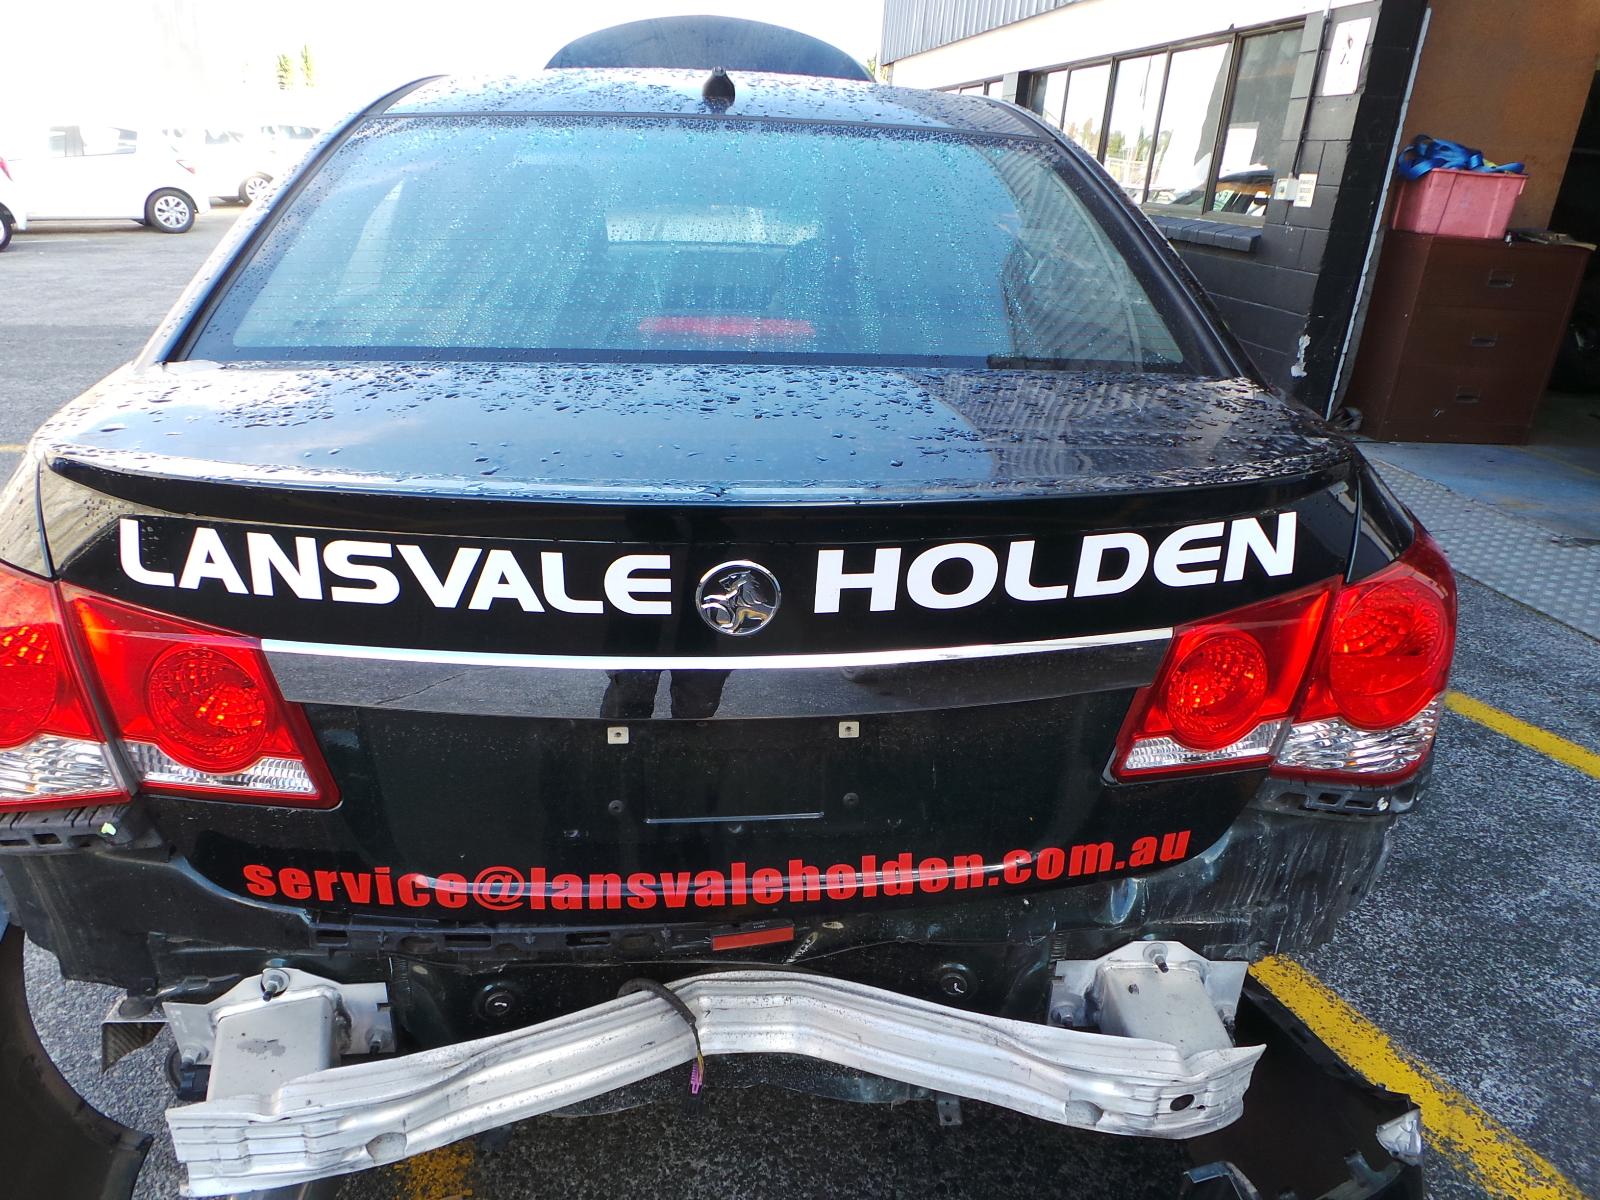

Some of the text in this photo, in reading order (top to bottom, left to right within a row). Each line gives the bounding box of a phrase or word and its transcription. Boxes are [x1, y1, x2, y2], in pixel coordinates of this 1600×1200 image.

[119, 511, 1297, 616] LANSVALE HOLDEN
[243, 830, 1192, 911] service@lansvaleholden.com.au
